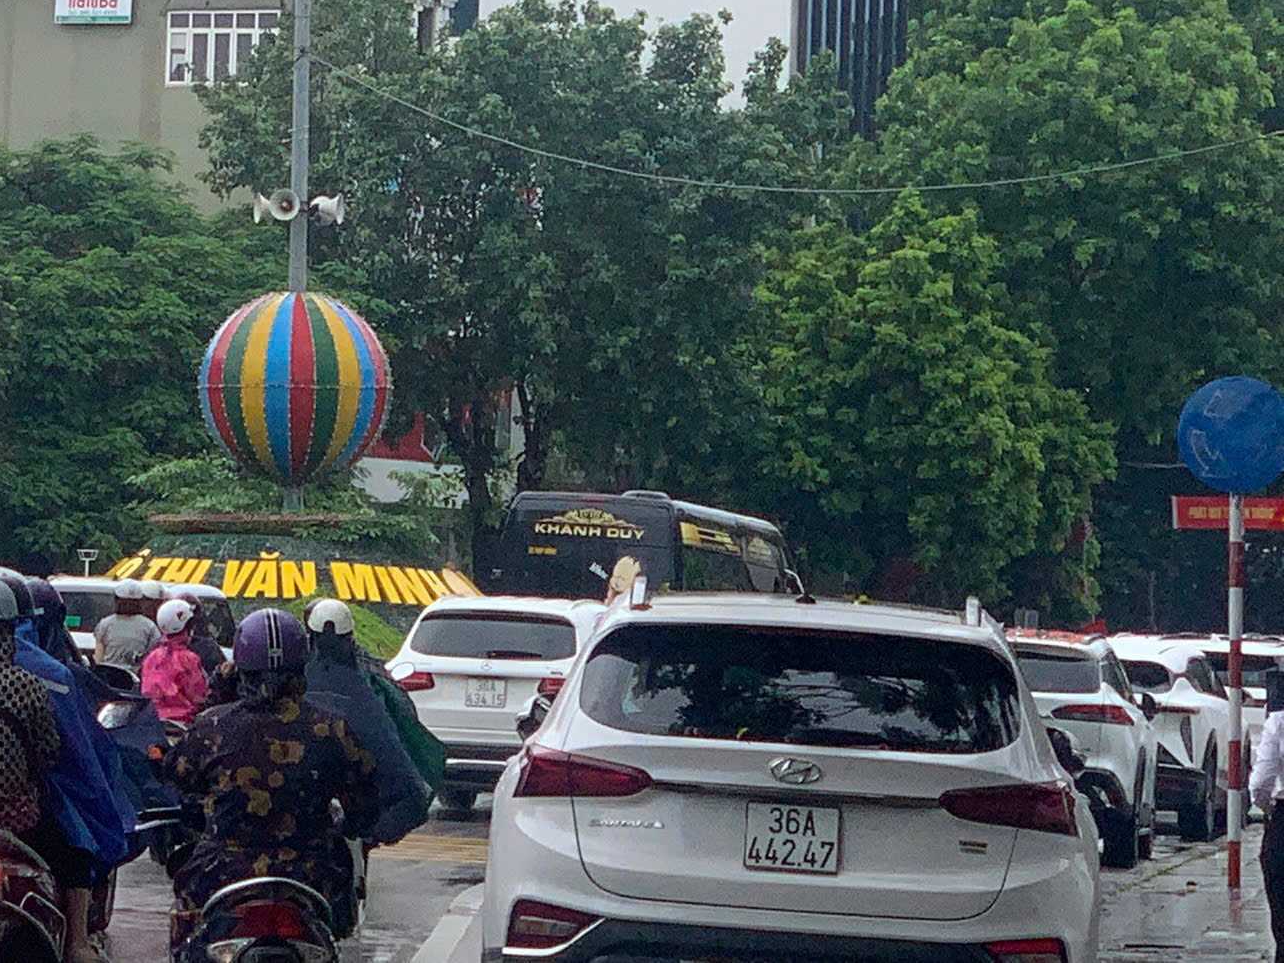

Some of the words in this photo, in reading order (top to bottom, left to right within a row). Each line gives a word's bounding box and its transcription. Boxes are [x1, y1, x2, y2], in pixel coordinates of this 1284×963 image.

[606, 527, 645, 540] DUY
[221, 550, 316, 599] VĂN
[768, 806, 816, 836] 36A
[747, 838, 835, 869] 442.47
